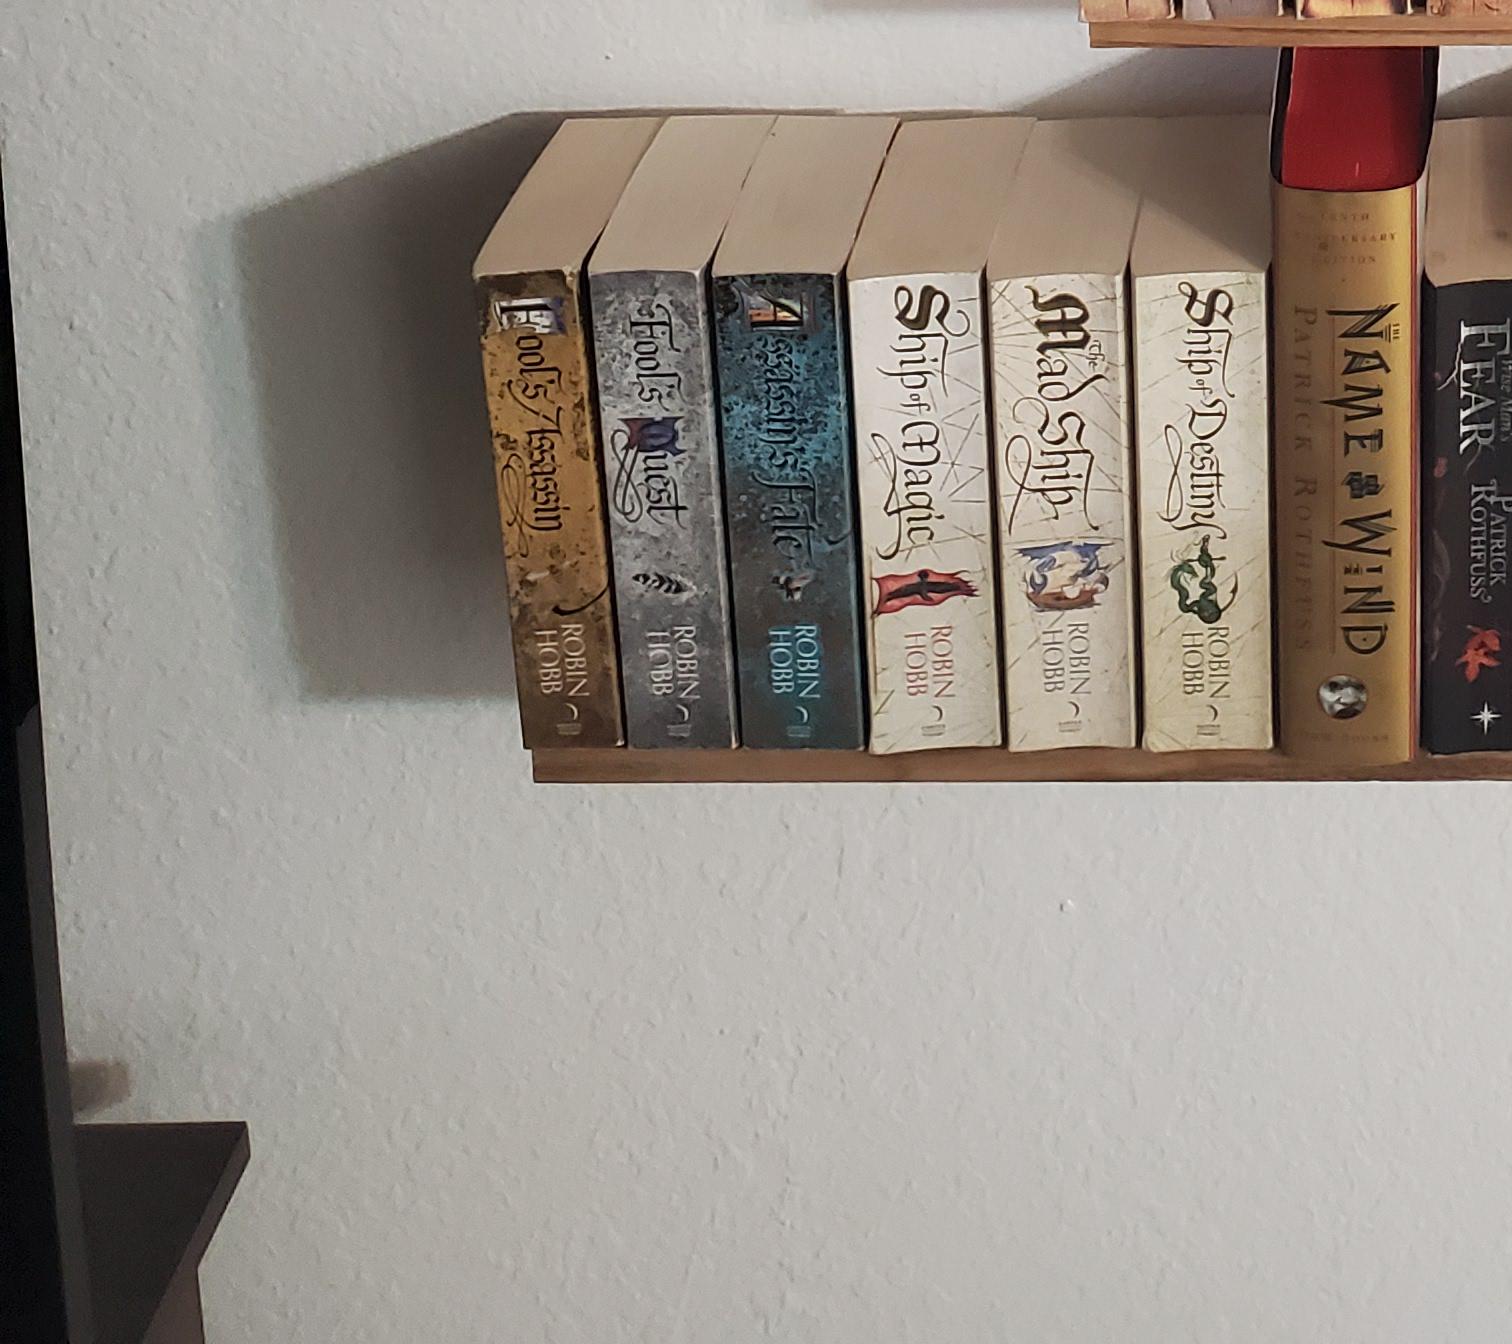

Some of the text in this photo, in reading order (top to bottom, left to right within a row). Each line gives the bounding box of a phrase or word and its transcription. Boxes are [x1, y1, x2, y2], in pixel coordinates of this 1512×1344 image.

[1320, 303, 1400, 457] NAME
[1458, 317, 1511, 455] FEAR
[871, 285, 971, 560] Ship of Magic
[1470, 478, 1497, 603] ROTHFUSS
[1322, 509, 1397, 655] WIND
[534, 630, 562, 694] HOBB
[561, 623, 590, 697] ROBIN
[768, 630, 794, 694] HOBB
[795, 624, 820, 699] ROBIN
[1042, 629, 1065, 692] HOBB
[1067, 622, 1091, 694] ROBIN
